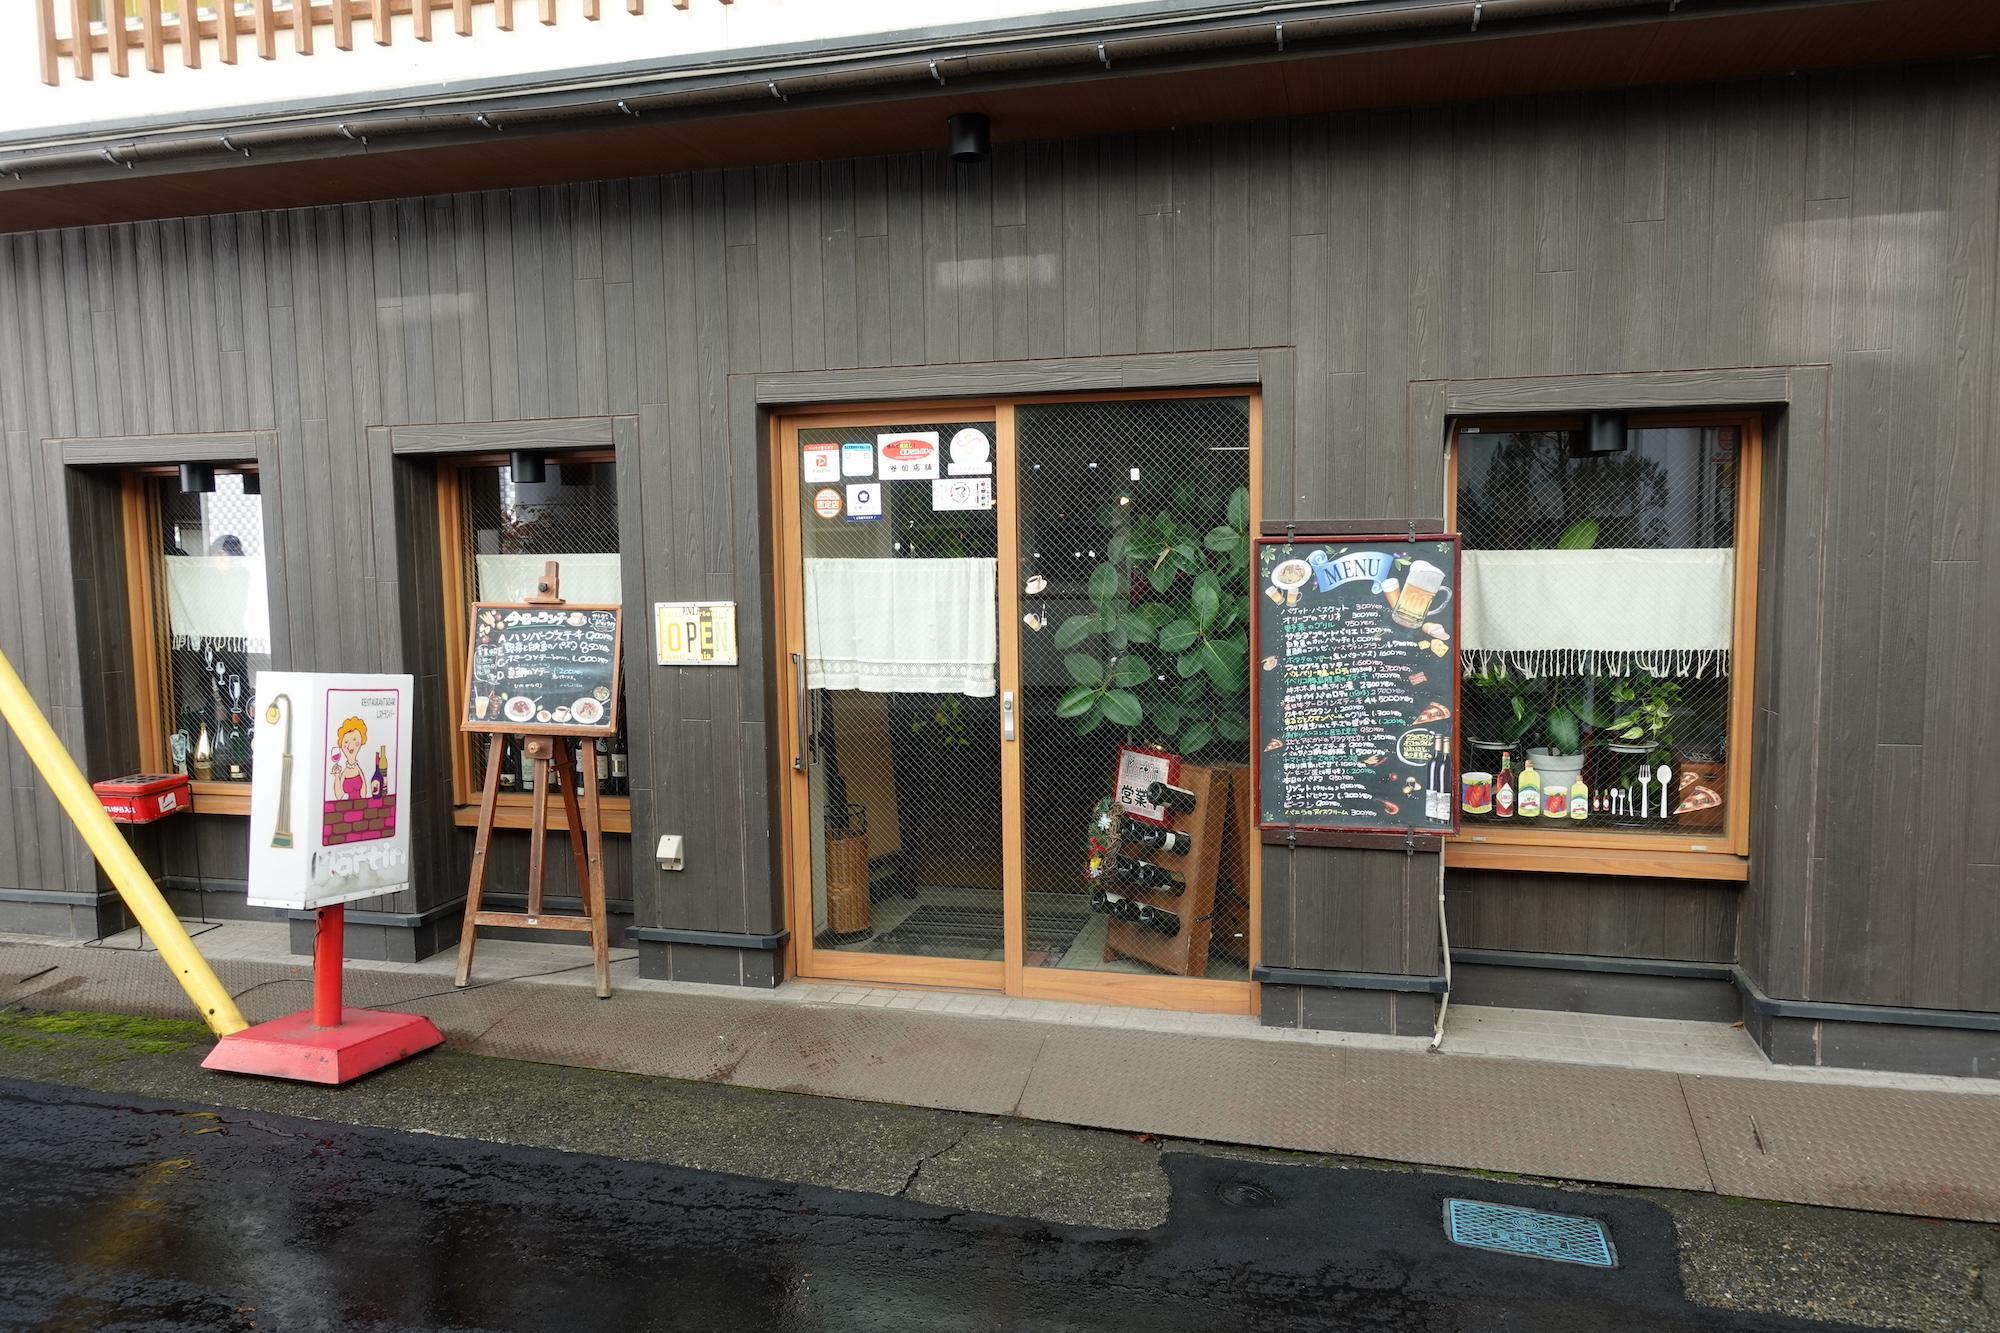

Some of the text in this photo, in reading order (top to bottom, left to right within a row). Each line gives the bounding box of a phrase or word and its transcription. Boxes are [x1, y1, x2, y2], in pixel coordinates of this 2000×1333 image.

[1324, 558, 1381, 585] MENU
[503, 611, 567, 626] 今日のランチ
[498, 633, 506, 644] A
[668, 622, 728, 653] OPEN
